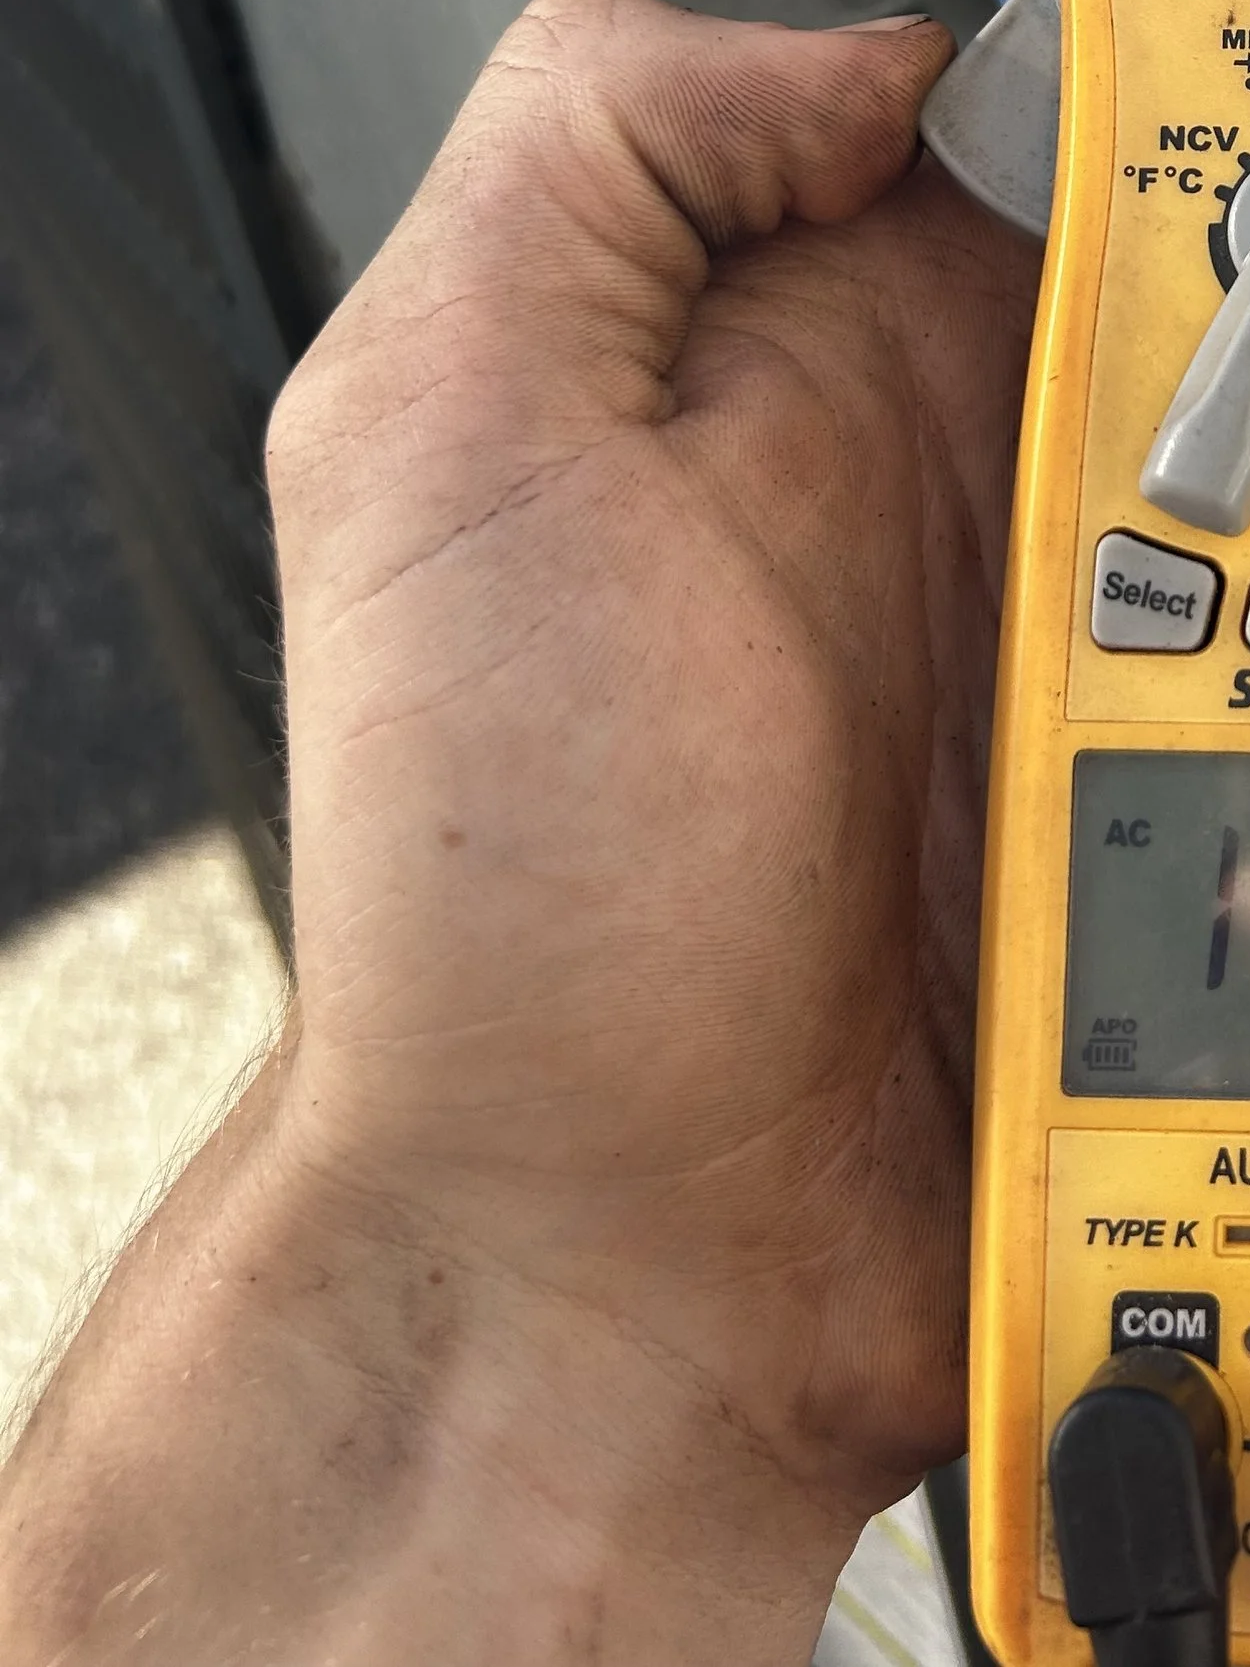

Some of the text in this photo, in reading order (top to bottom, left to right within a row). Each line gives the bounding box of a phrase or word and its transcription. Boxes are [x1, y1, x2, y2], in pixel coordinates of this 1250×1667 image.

[1159, 125, 1239, 152] NCV
[1102, 571, 1197, 620] Select
[1105, 818, 1151, 849] AC
[1091, 1017, 1137, 1035] APO
[1085, 1217, 1200, 1248] TYPE K
[1121, 1308, 1206, 1340] COM
